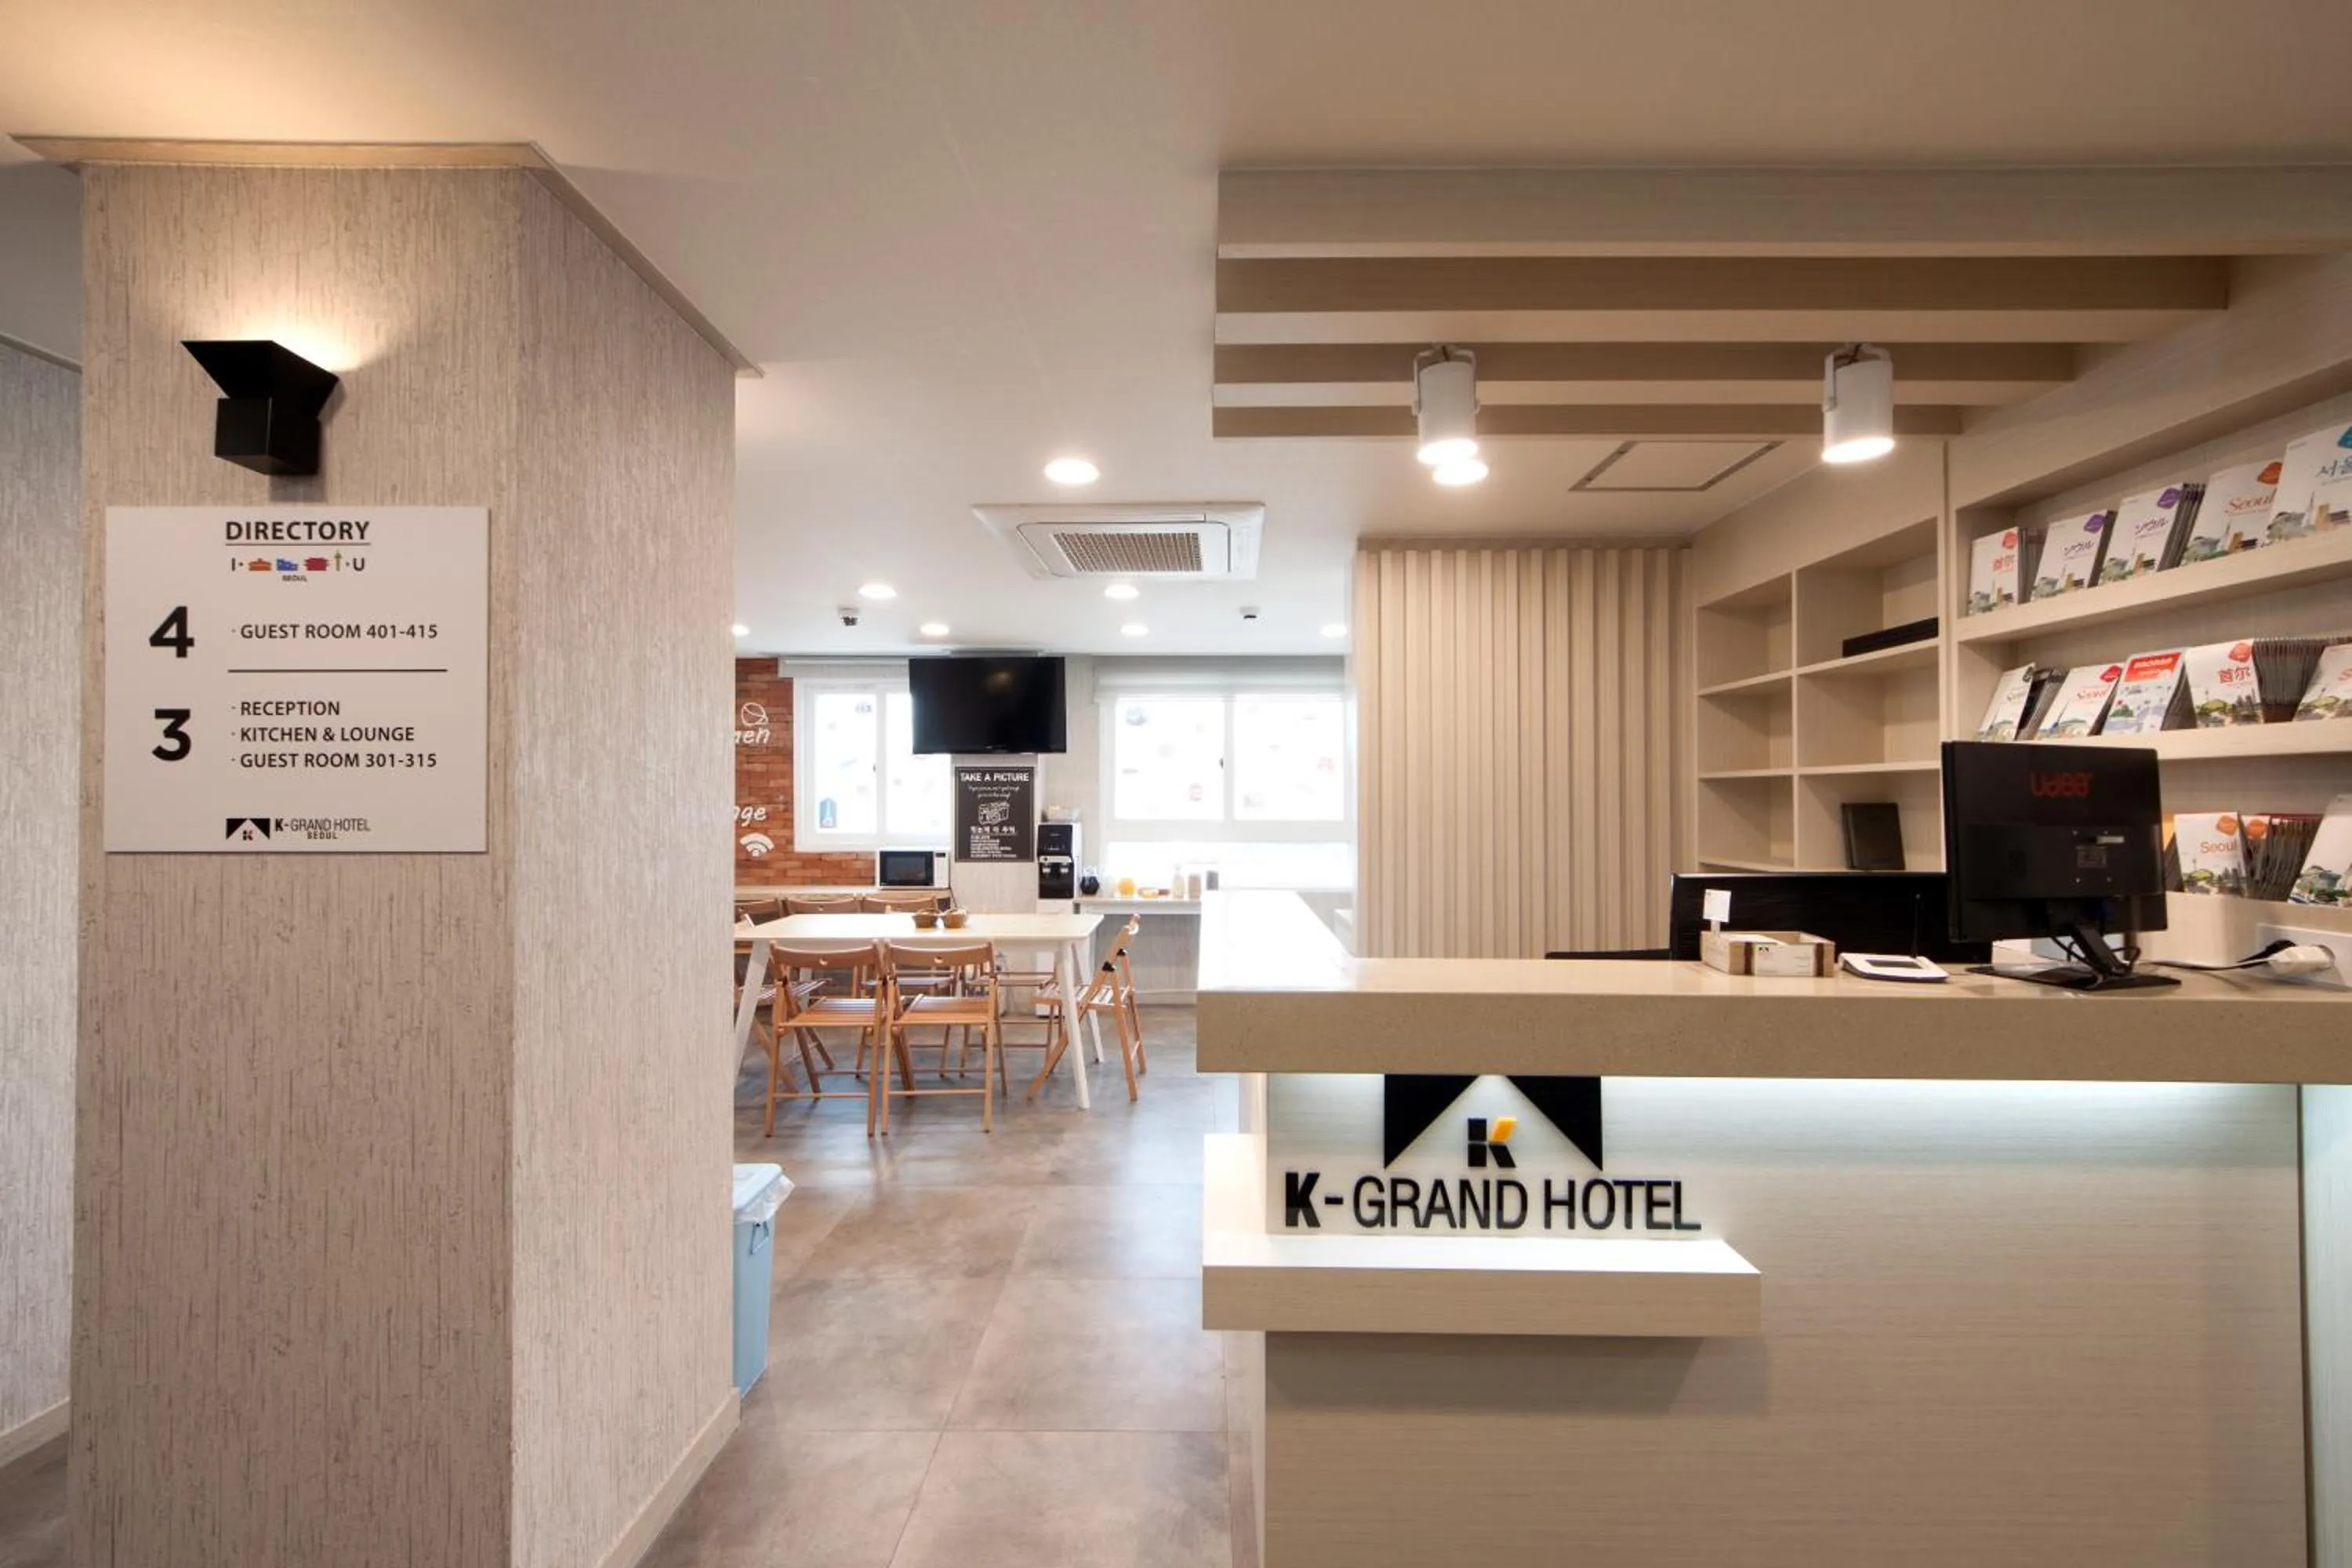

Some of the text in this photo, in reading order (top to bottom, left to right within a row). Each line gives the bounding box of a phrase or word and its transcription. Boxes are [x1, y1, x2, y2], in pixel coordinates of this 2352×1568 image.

[2228, 488, 2278, 510] Seoul
[226, 521, 369, 540] DIRECTORY
[149, 605, 194, 658] 4
[240, 624, 438, 639] GUEST ROOM 401-415
[240, 701, 340, 716] RECEPTION
[151, 709, 191, 761] 3
[240, 727, 416, 742] KITCHEN & LOUNGE
[240, 753, 437, 768] GUEST ROOM 301-315
[960, 772, 1029, 782] TAKE A PICTURE
[275, 818, 371, 832] K-GRAND HOTEL
[307, 831, 338, 840] SEOUL
[2200, 840, 2237, 854] Seoul
[1284, 1172, 1702, 1231] K-GRAND HOTEL
